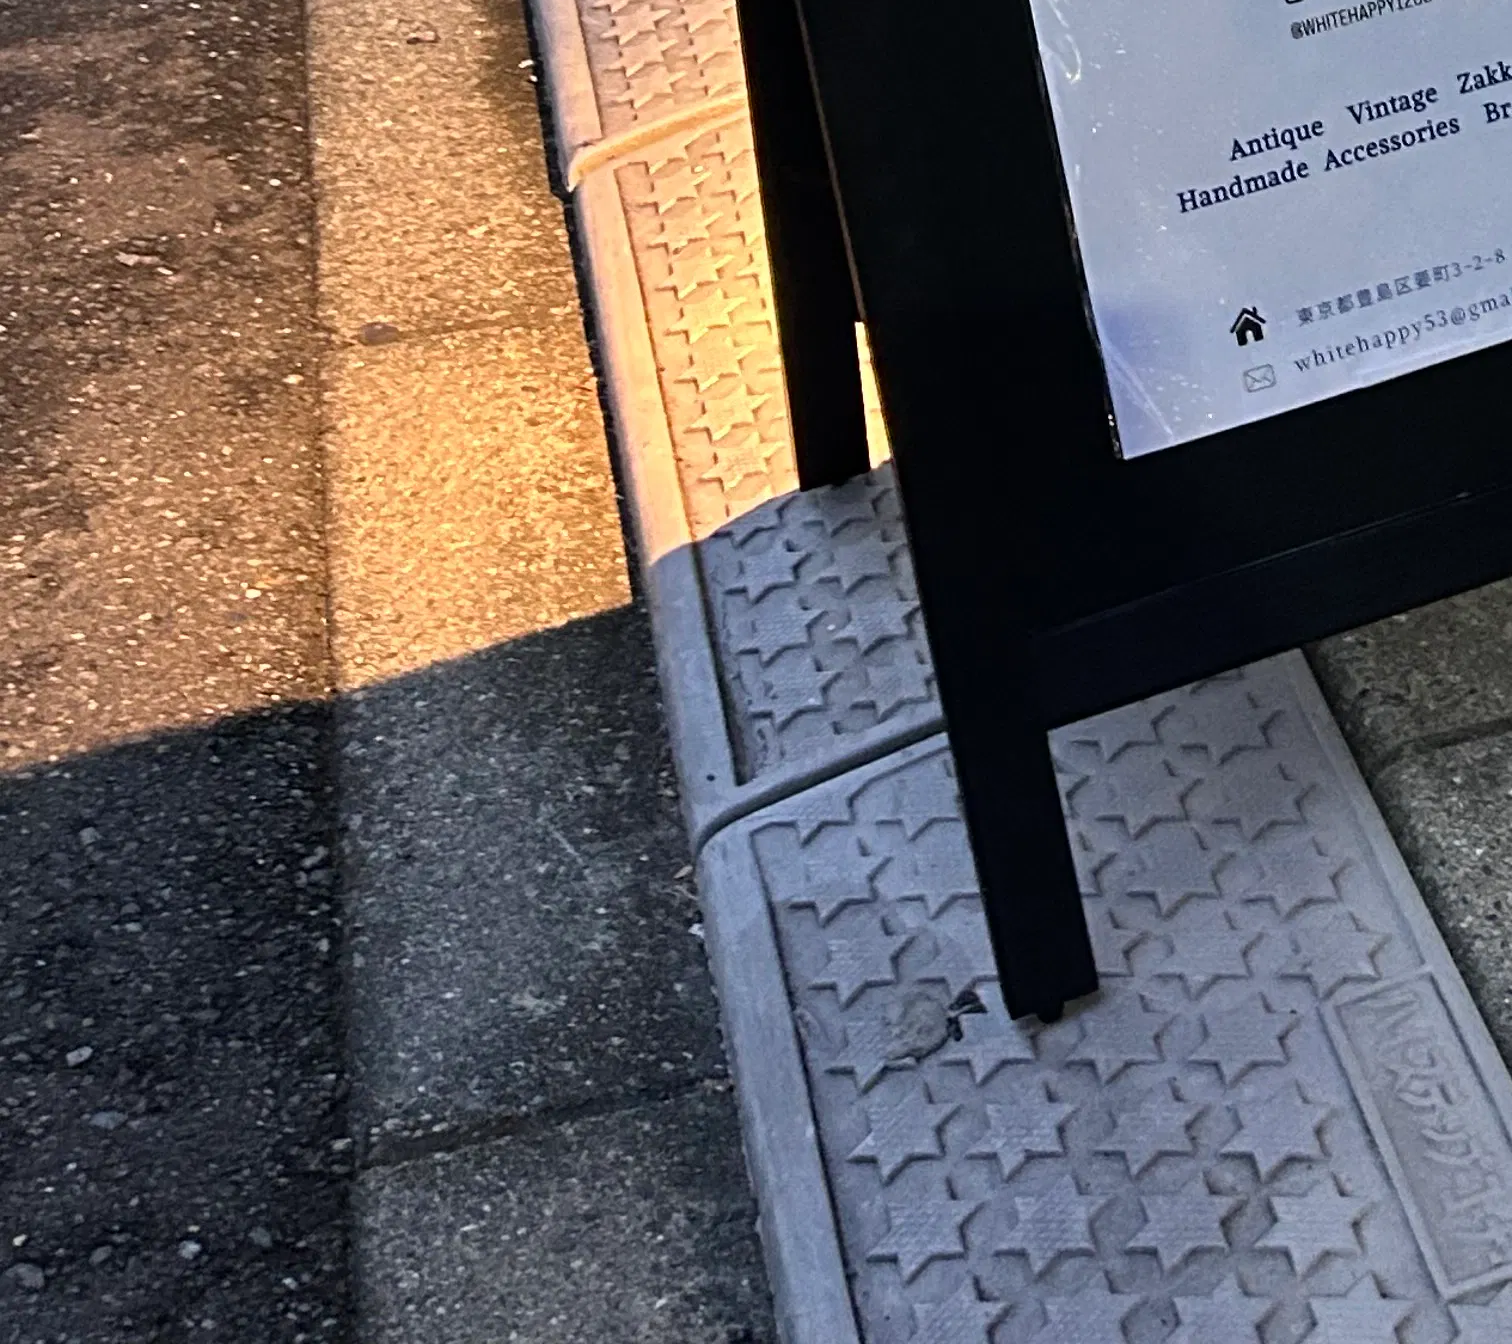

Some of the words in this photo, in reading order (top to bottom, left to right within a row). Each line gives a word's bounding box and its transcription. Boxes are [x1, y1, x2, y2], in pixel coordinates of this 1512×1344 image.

[1176, 160, 1310, 214] Handmade
[1323, 116, 1461, 172] Accessories
[1228, 116, 1325, 162] Antique
[1345, 85, 1440, 126] Vintage
